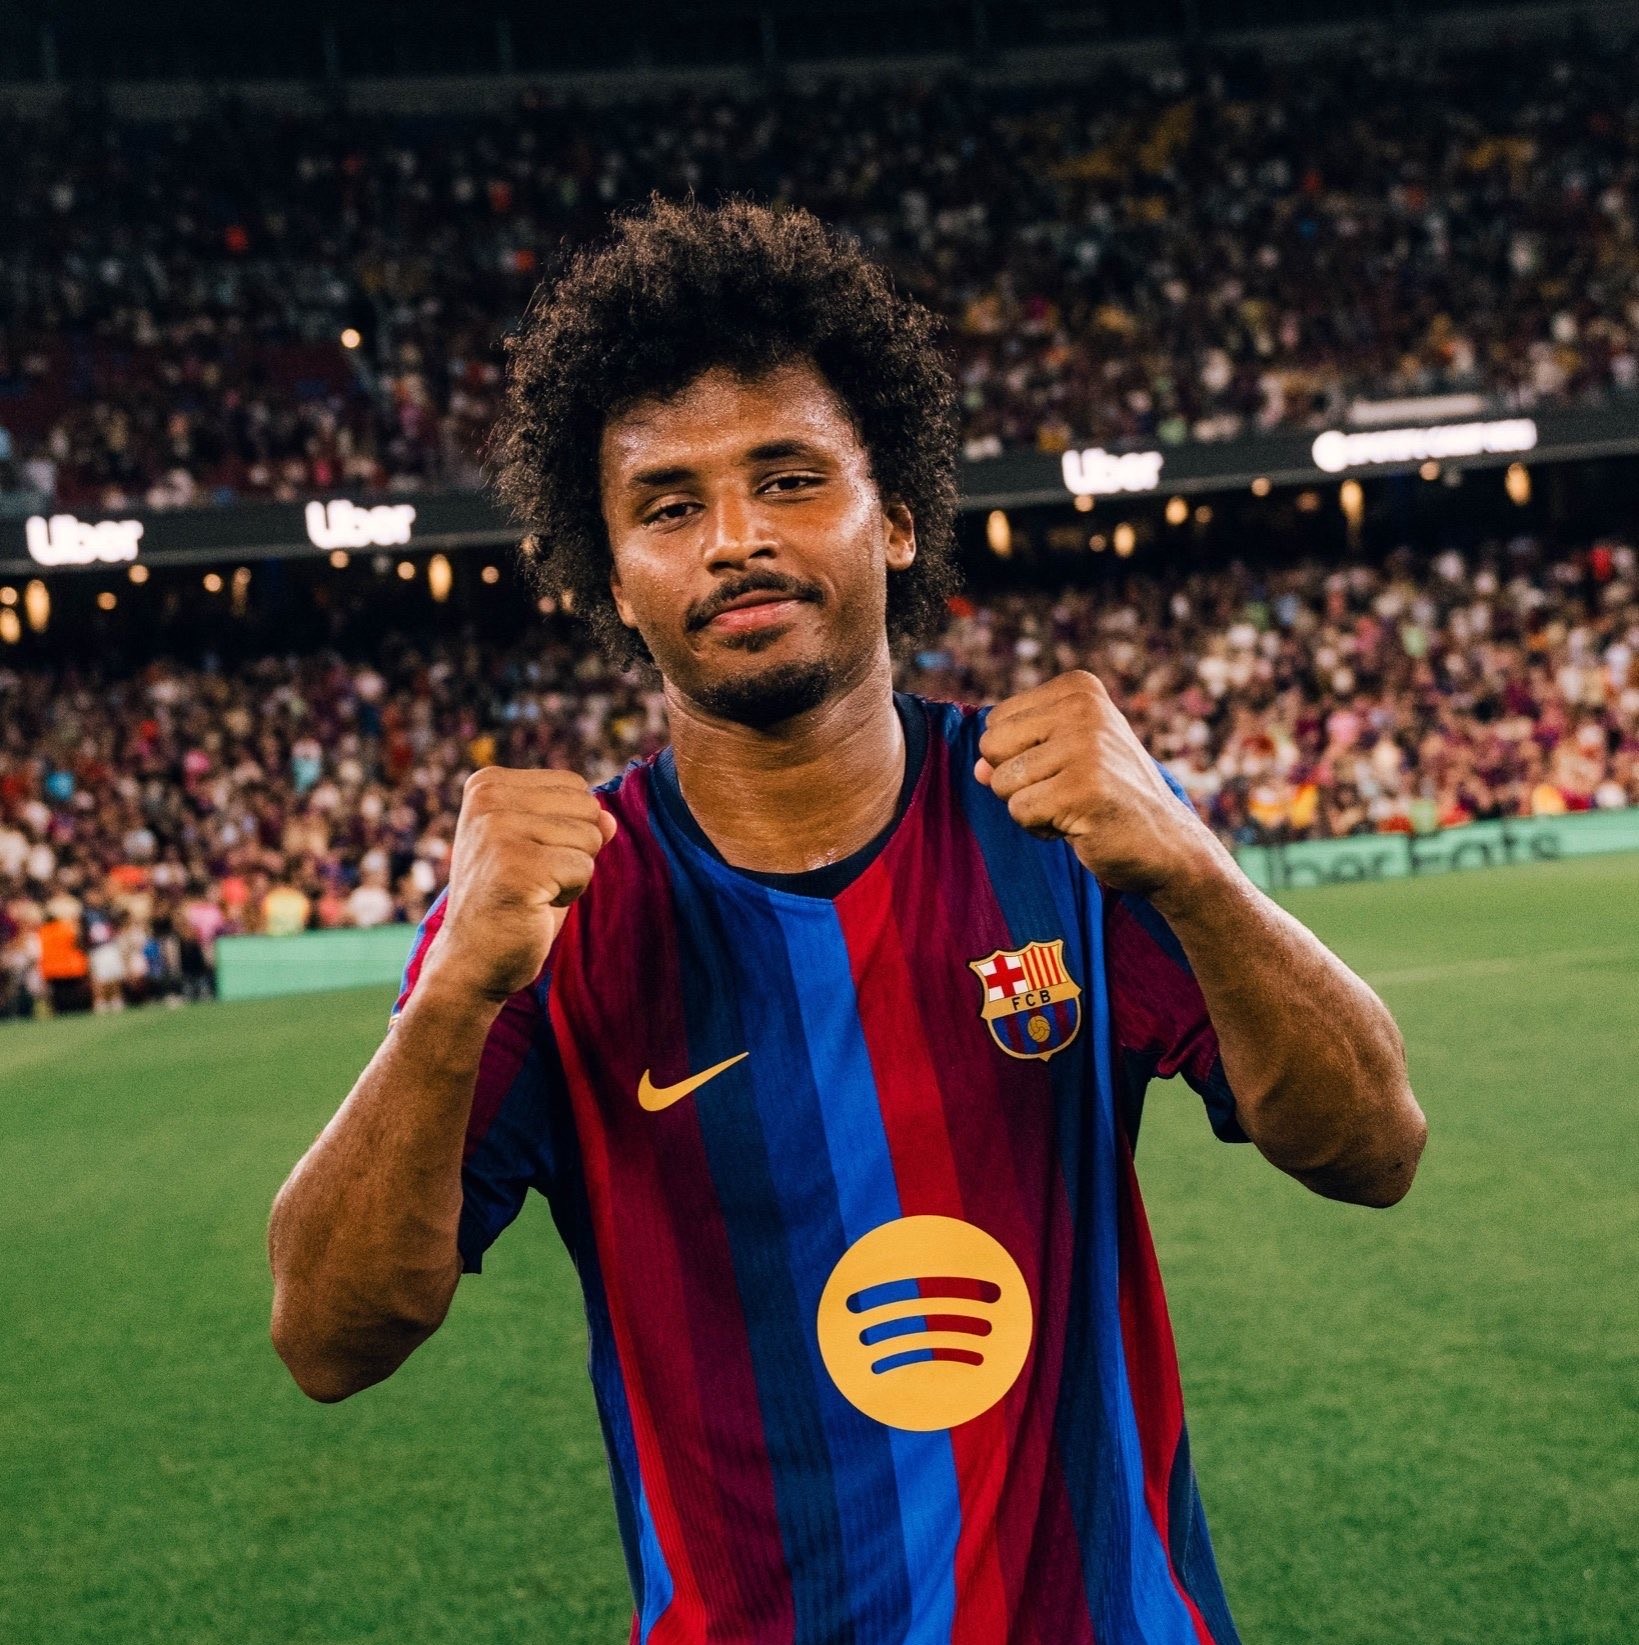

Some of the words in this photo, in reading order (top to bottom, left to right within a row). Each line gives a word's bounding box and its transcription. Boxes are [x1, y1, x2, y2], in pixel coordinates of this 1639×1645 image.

[1062, 448, 1162, 496] Uber
[27, 515, 143, 566] Uber
[306, 500, 415, 549] Uber
